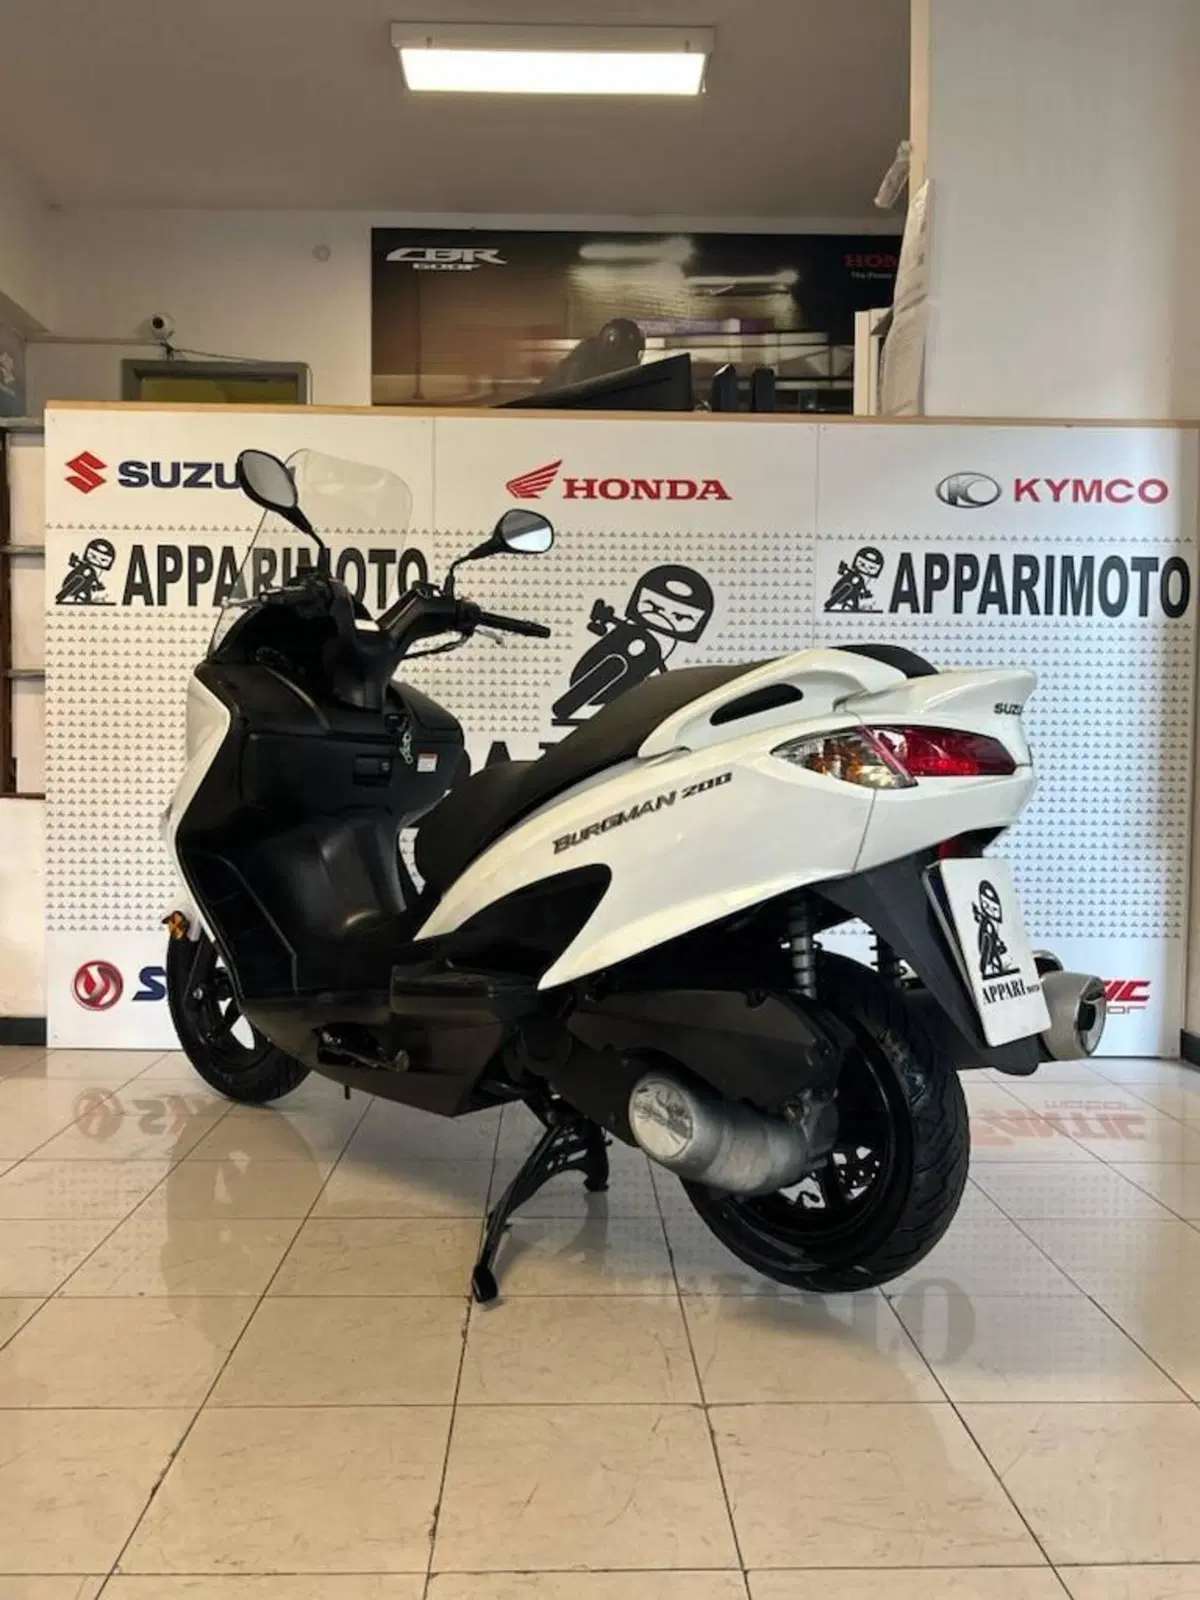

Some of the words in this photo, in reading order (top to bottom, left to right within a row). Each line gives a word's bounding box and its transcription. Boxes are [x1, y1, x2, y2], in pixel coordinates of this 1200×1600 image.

[386, 247, 508, 265] CBR
[843, 253, 900, 269] HON
[118, 460, 296, 489] SUZU
[562, 478, 733, 500] HONDA
[1013, 478, 1169, 504] KYMCO
[888, 552, 1191, 619] APPARIMOTO
[552, 790, 677, 855] BURGMAN
[681, 771, 733, 800] 200
[982, 978, 1026, 1006] APPARI
